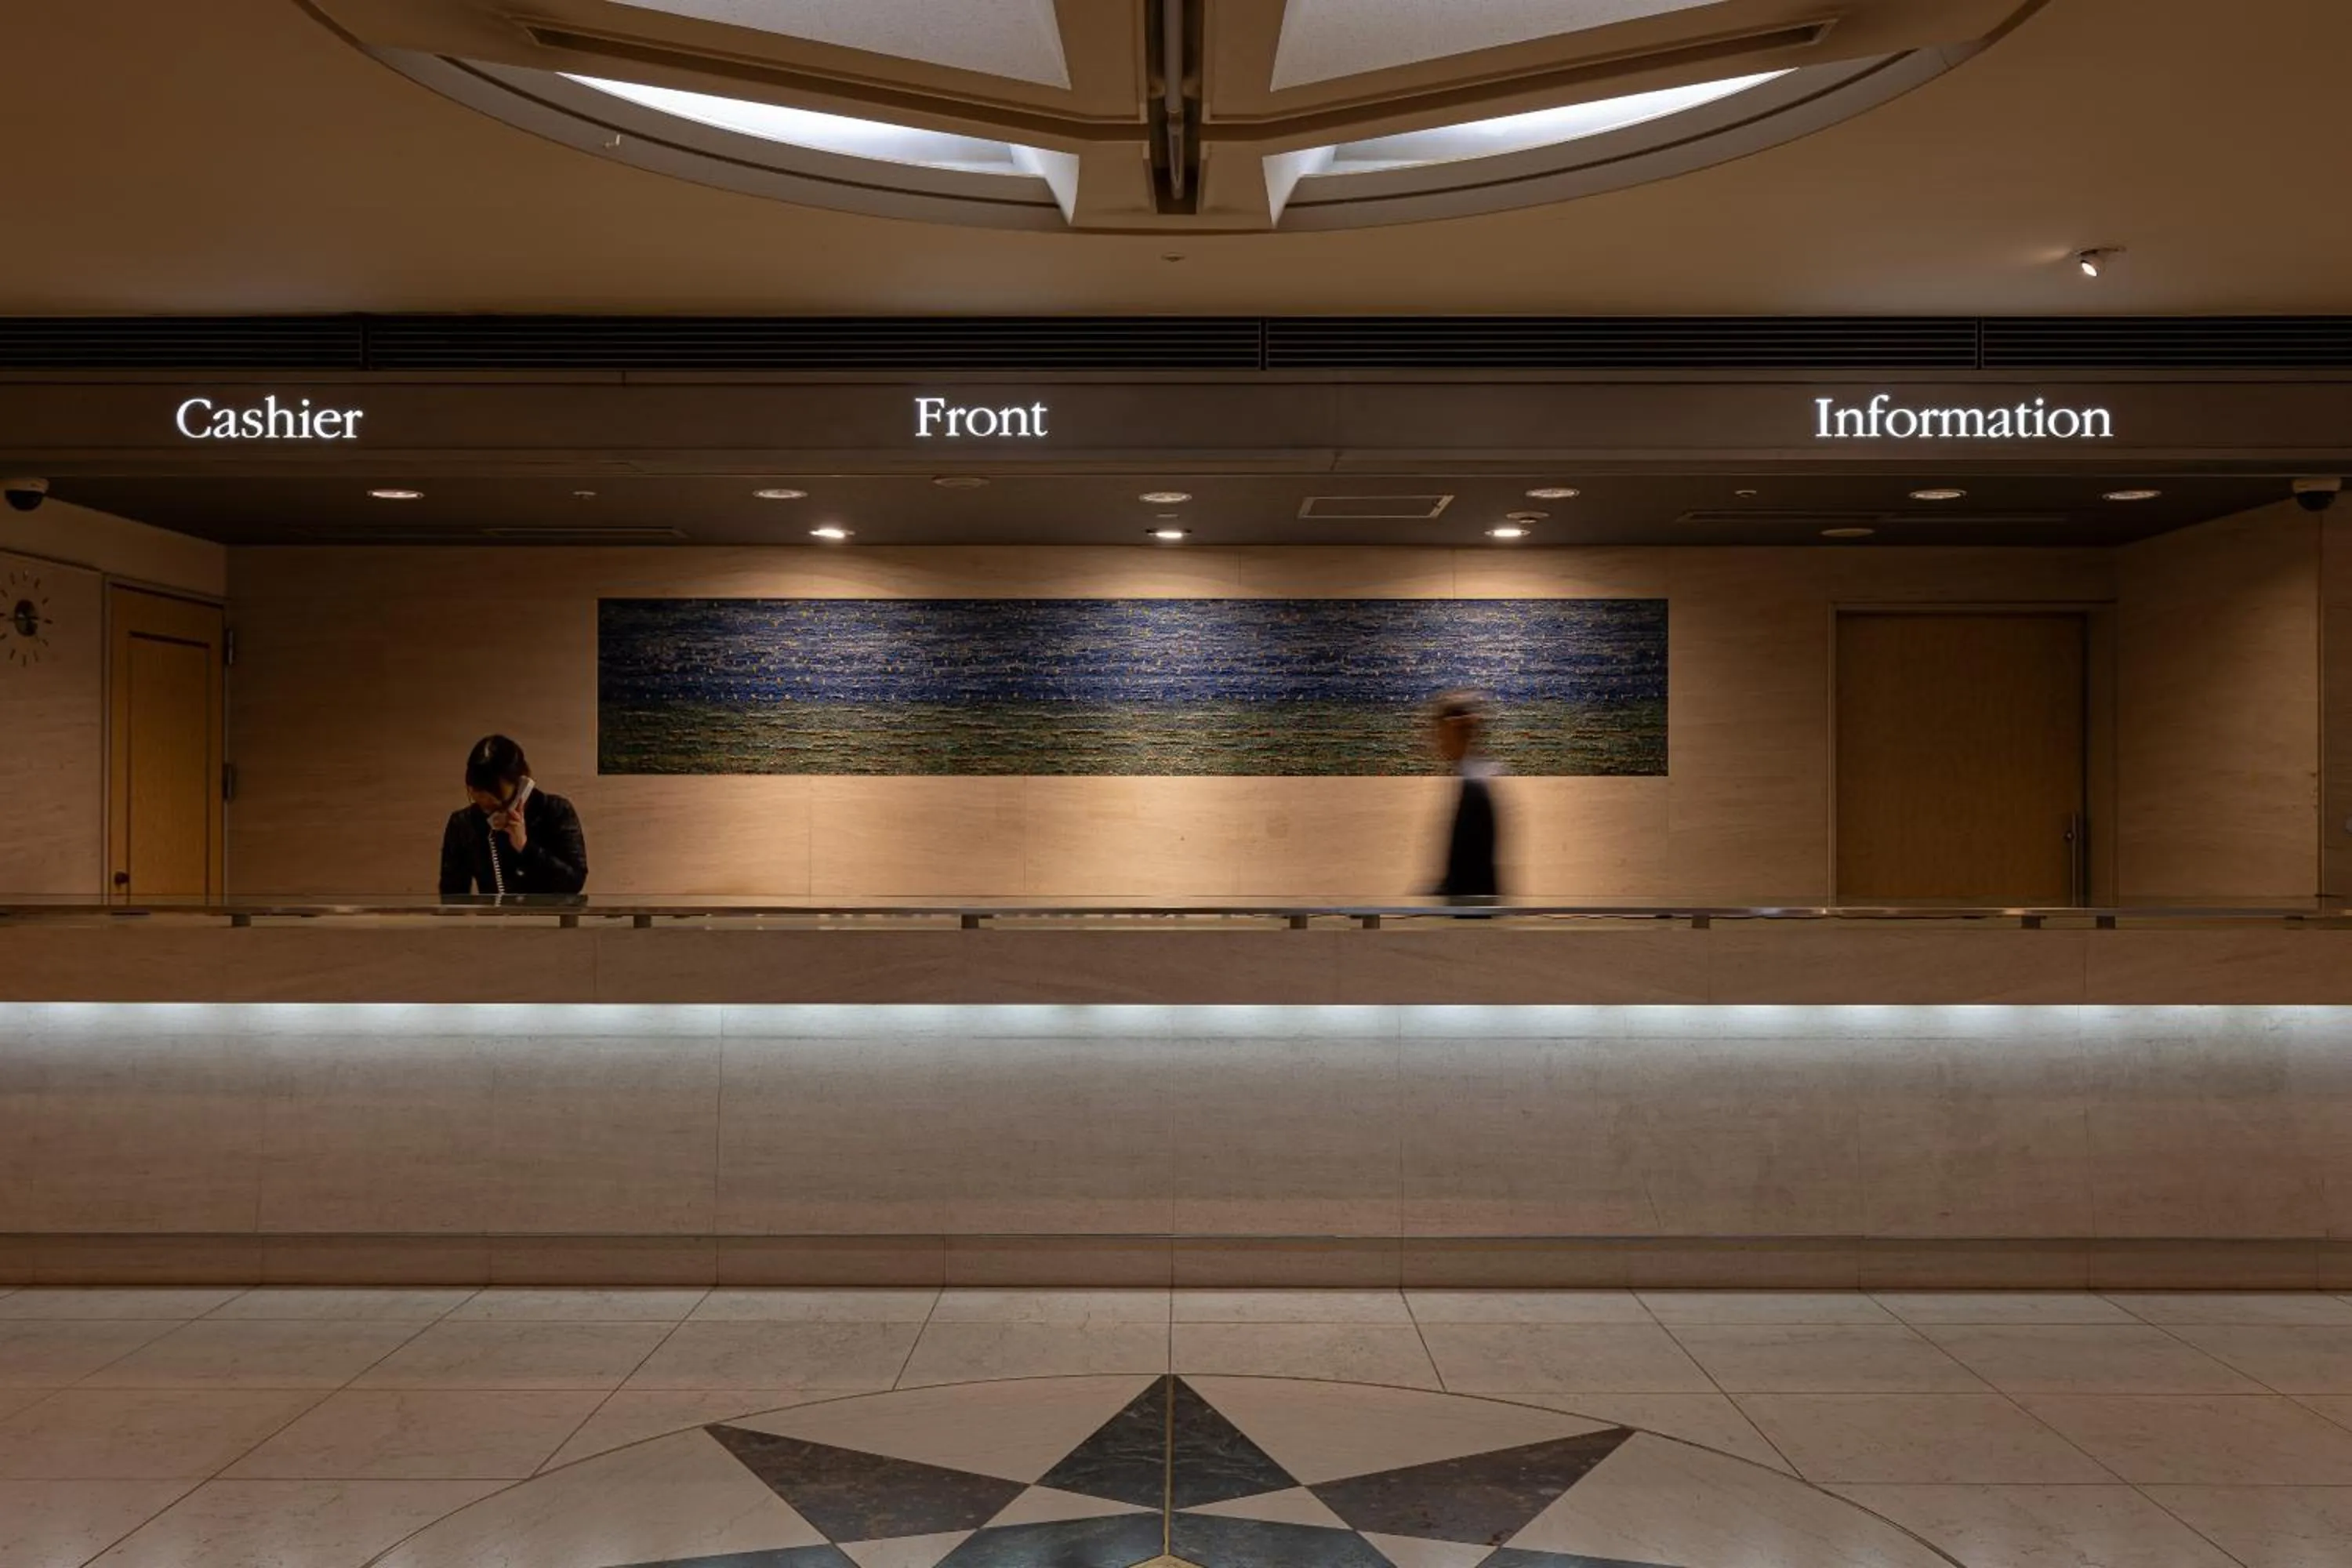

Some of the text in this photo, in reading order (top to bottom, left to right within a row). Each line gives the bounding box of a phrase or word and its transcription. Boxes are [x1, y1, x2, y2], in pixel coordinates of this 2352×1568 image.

[176, 394, 363, 438] Cashier
[914, 397, 1047, 437] Front
[1814, 394, 2113, 437] Information
